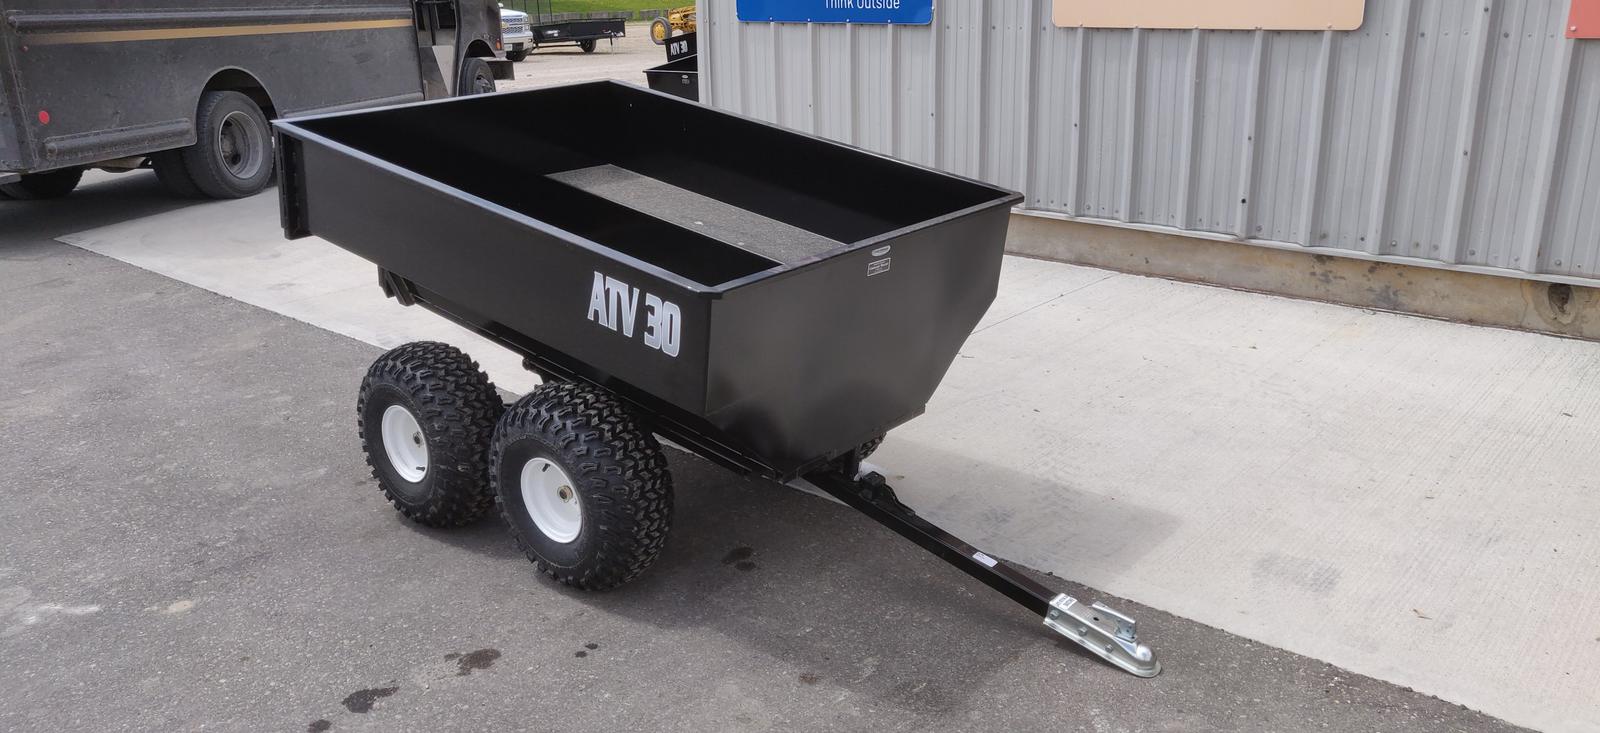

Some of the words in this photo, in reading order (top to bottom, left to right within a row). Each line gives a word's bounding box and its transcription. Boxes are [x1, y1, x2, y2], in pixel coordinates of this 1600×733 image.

[825, 0, 854, 9] Think
[856, 0, 900, 9] Outside
[670, 41, 680, 56] ATV
[680, 40, 688, 53] 30
[587, 270, 640, 338] ATV
[644, 292, 681, 358] 30
